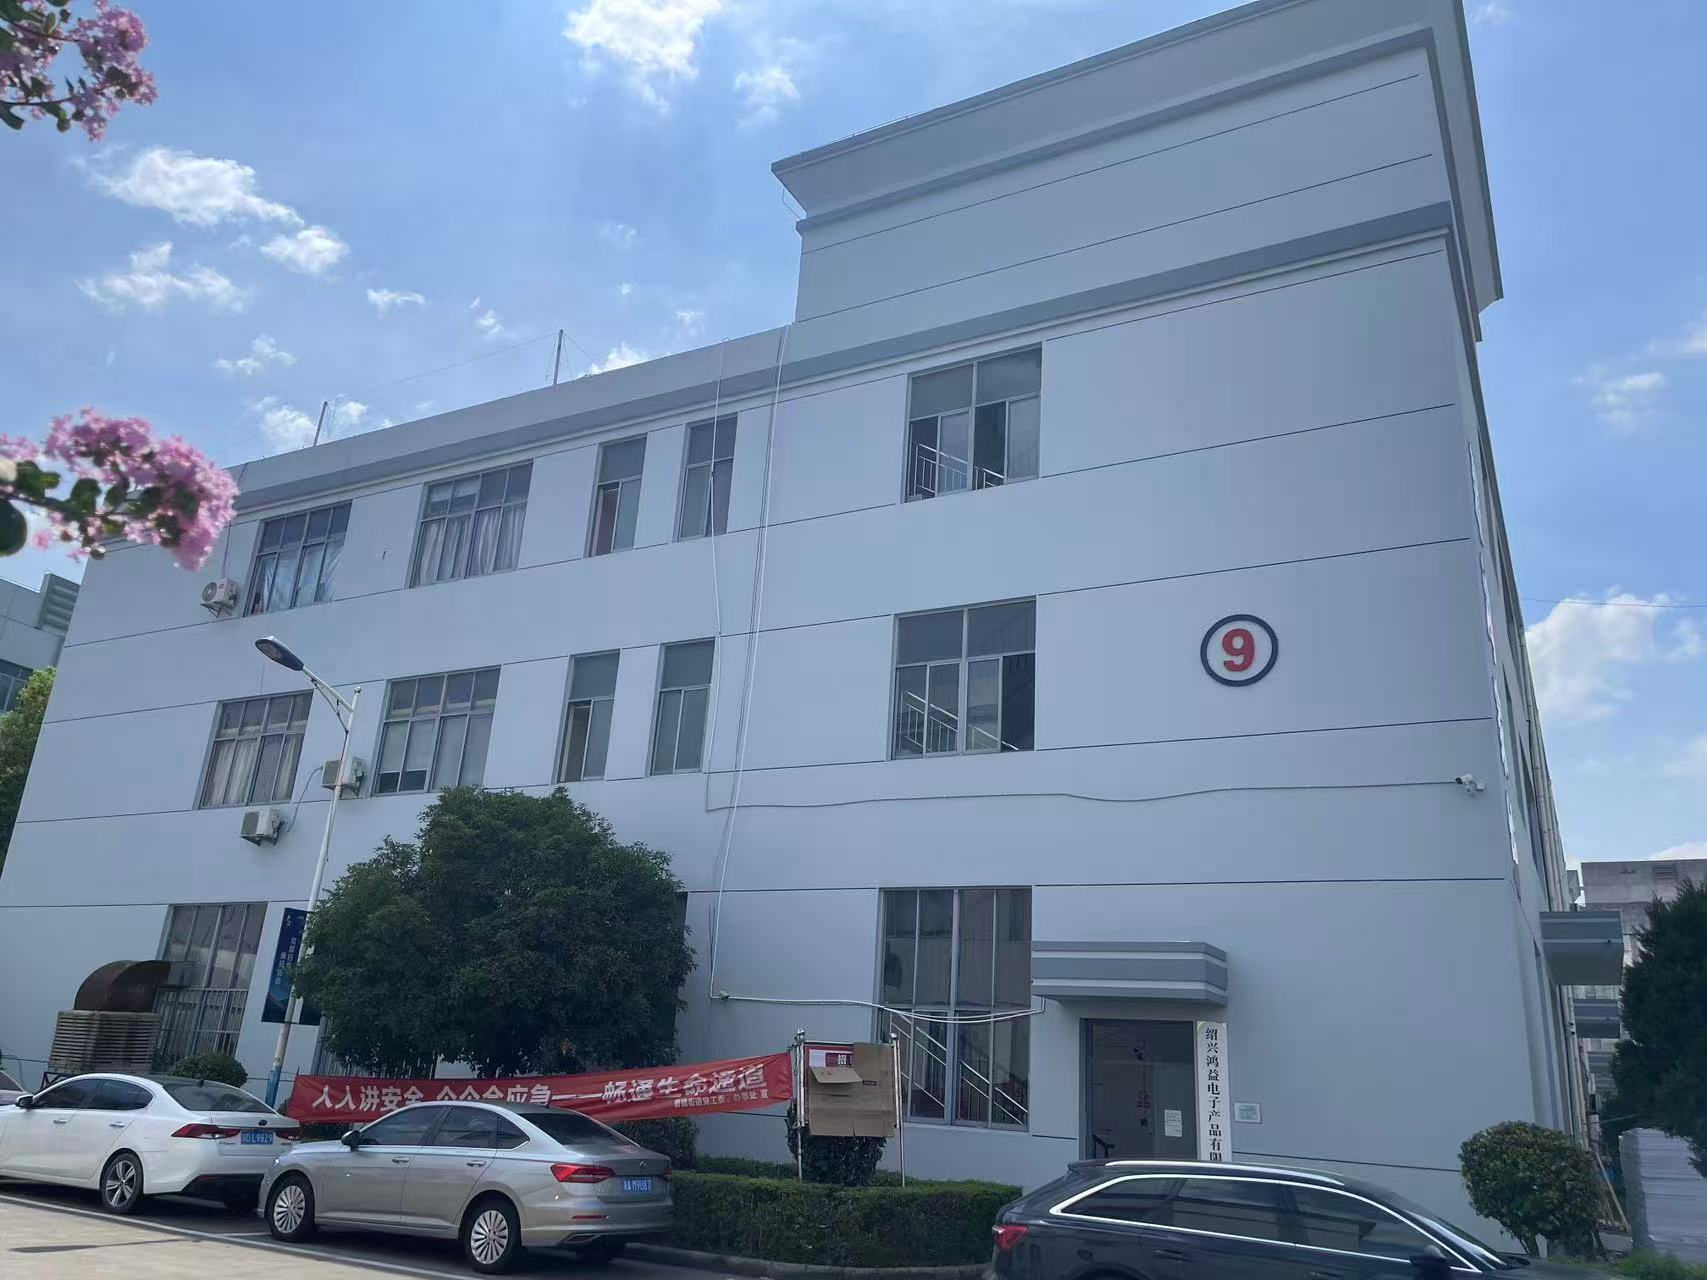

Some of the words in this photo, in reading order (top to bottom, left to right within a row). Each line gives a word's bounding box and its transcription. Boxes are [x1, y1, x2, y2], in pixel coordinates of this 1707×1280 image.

[1222, 628, 1255, 672] 9
[1205, 1028, 1222, 1161] 绍兴鸿益电子产品有限
